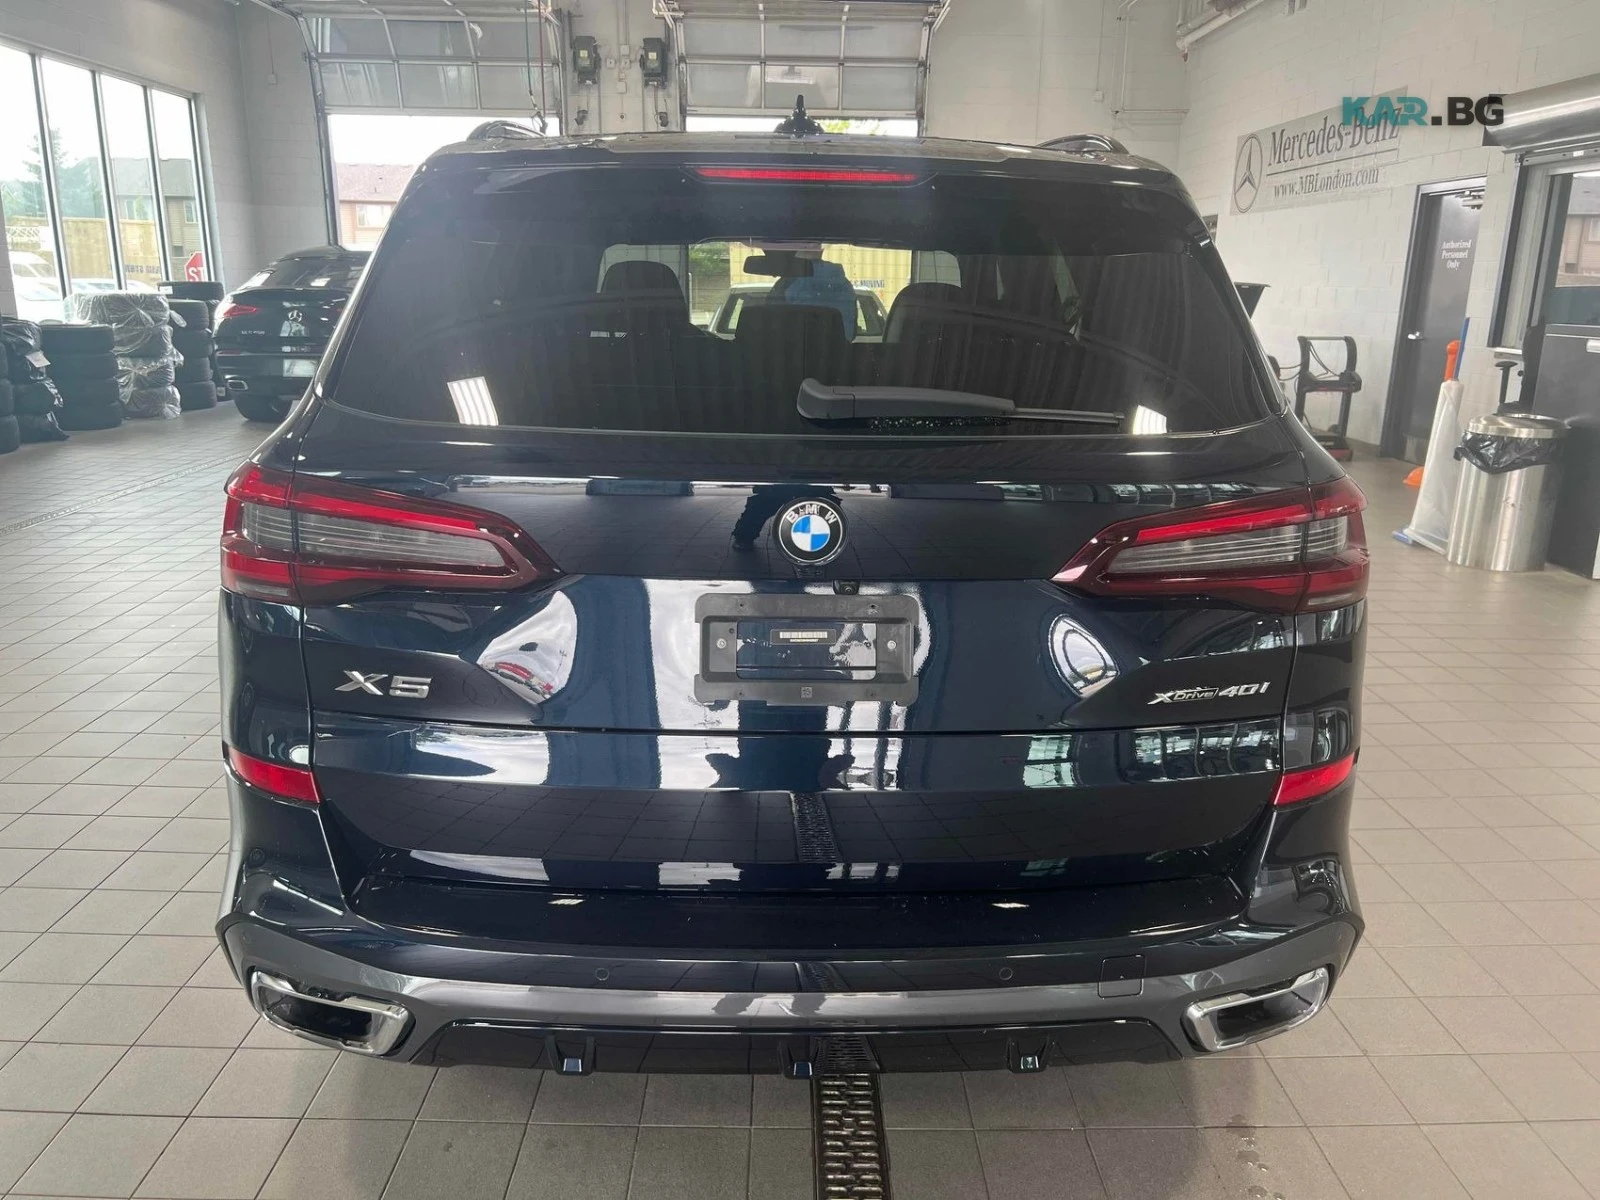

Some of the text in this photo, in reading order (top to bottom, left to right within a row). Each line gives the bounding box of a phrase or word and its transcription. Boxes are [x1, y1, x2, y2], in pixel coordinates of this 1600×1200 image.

[1267, 106, 1402, 167] Mercedes-Benz
[1274, 167, 1380, 199] www.MBLondon.com
[1440, 239, 1472, 249] Authorized
[1441, 249, 1469, 259] Personnel
[1446, 259, 1460, 271] Only
[786, 503, 837, 524] BMW
[334, 670, 433, 699] X5
